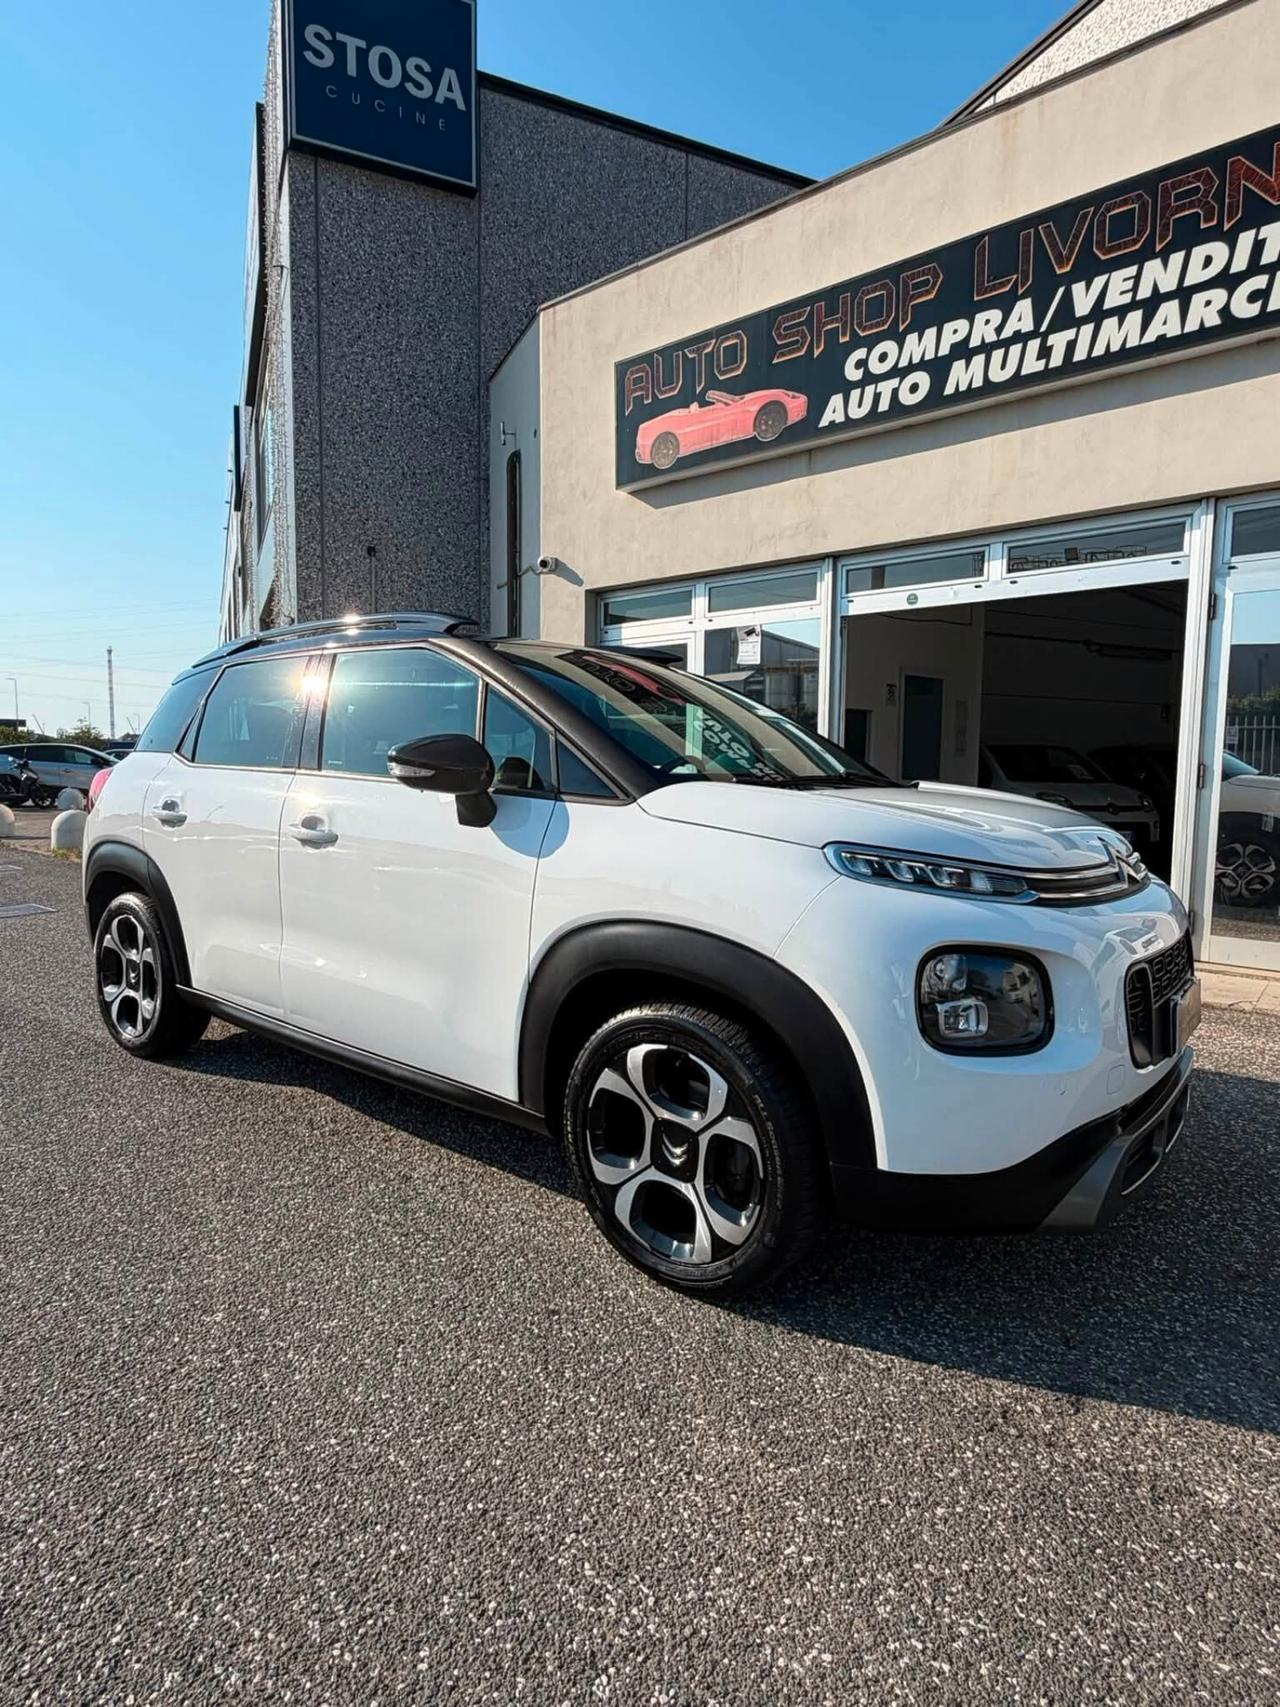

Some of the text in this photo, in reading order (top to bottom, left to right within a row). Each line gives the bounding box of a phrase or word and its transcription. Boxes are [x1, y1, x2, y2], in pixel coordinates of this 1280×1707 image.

[303, 24, 466, 111] STOSA
[325, 85, 446, 131] CUCINE
[625, 330, 747, 416] AUTO
[772, 262, 944, 364] SHOP
[818, 371, 931, 428] AUTO
